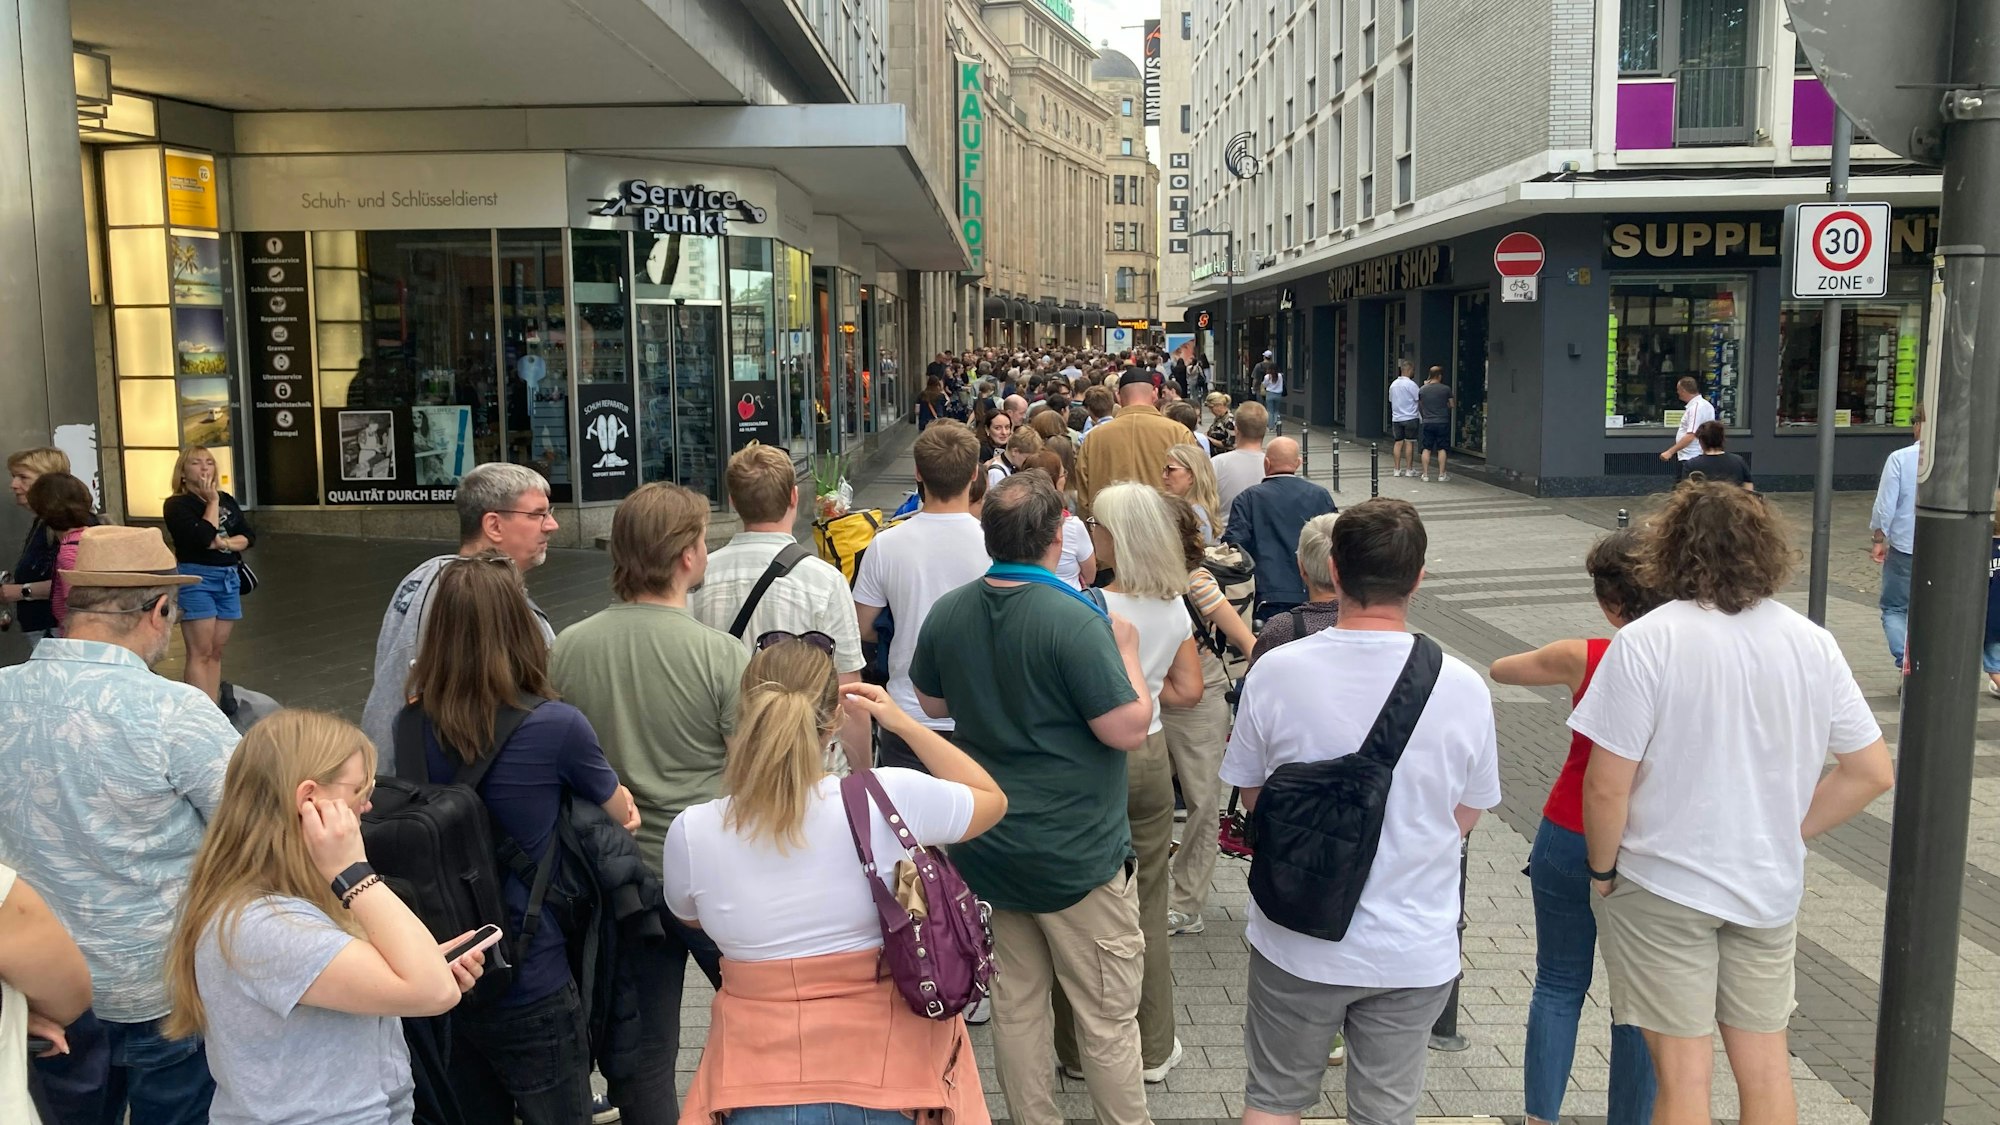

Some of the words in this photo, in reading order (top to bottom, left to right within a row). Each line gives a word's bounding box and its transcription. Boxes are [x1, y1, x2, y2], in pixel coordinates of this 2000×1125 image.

[1146, 57, 1160, 120] SATURN
[301, 192, 351, 209] Schuh-
[358, 190, 385, 208] und
[392, 189, 499, 208] Schlüsseldienst
[630, 180, 737, 210] Service
[1172, 155, 1187, 252] HOTEL
[643, 207, 728, 235] Punkt
[1825, 227, 1859, 255] 30
[1328, 254, 1398, 301] SUPPLEMENT
[1401, 244, 1440, 289] SHOP
[1817, 276, 1863, 290] ZONE
[328, 487, 385, 503] QUALITÄT
[387, 489, 429, 501] DURCH
